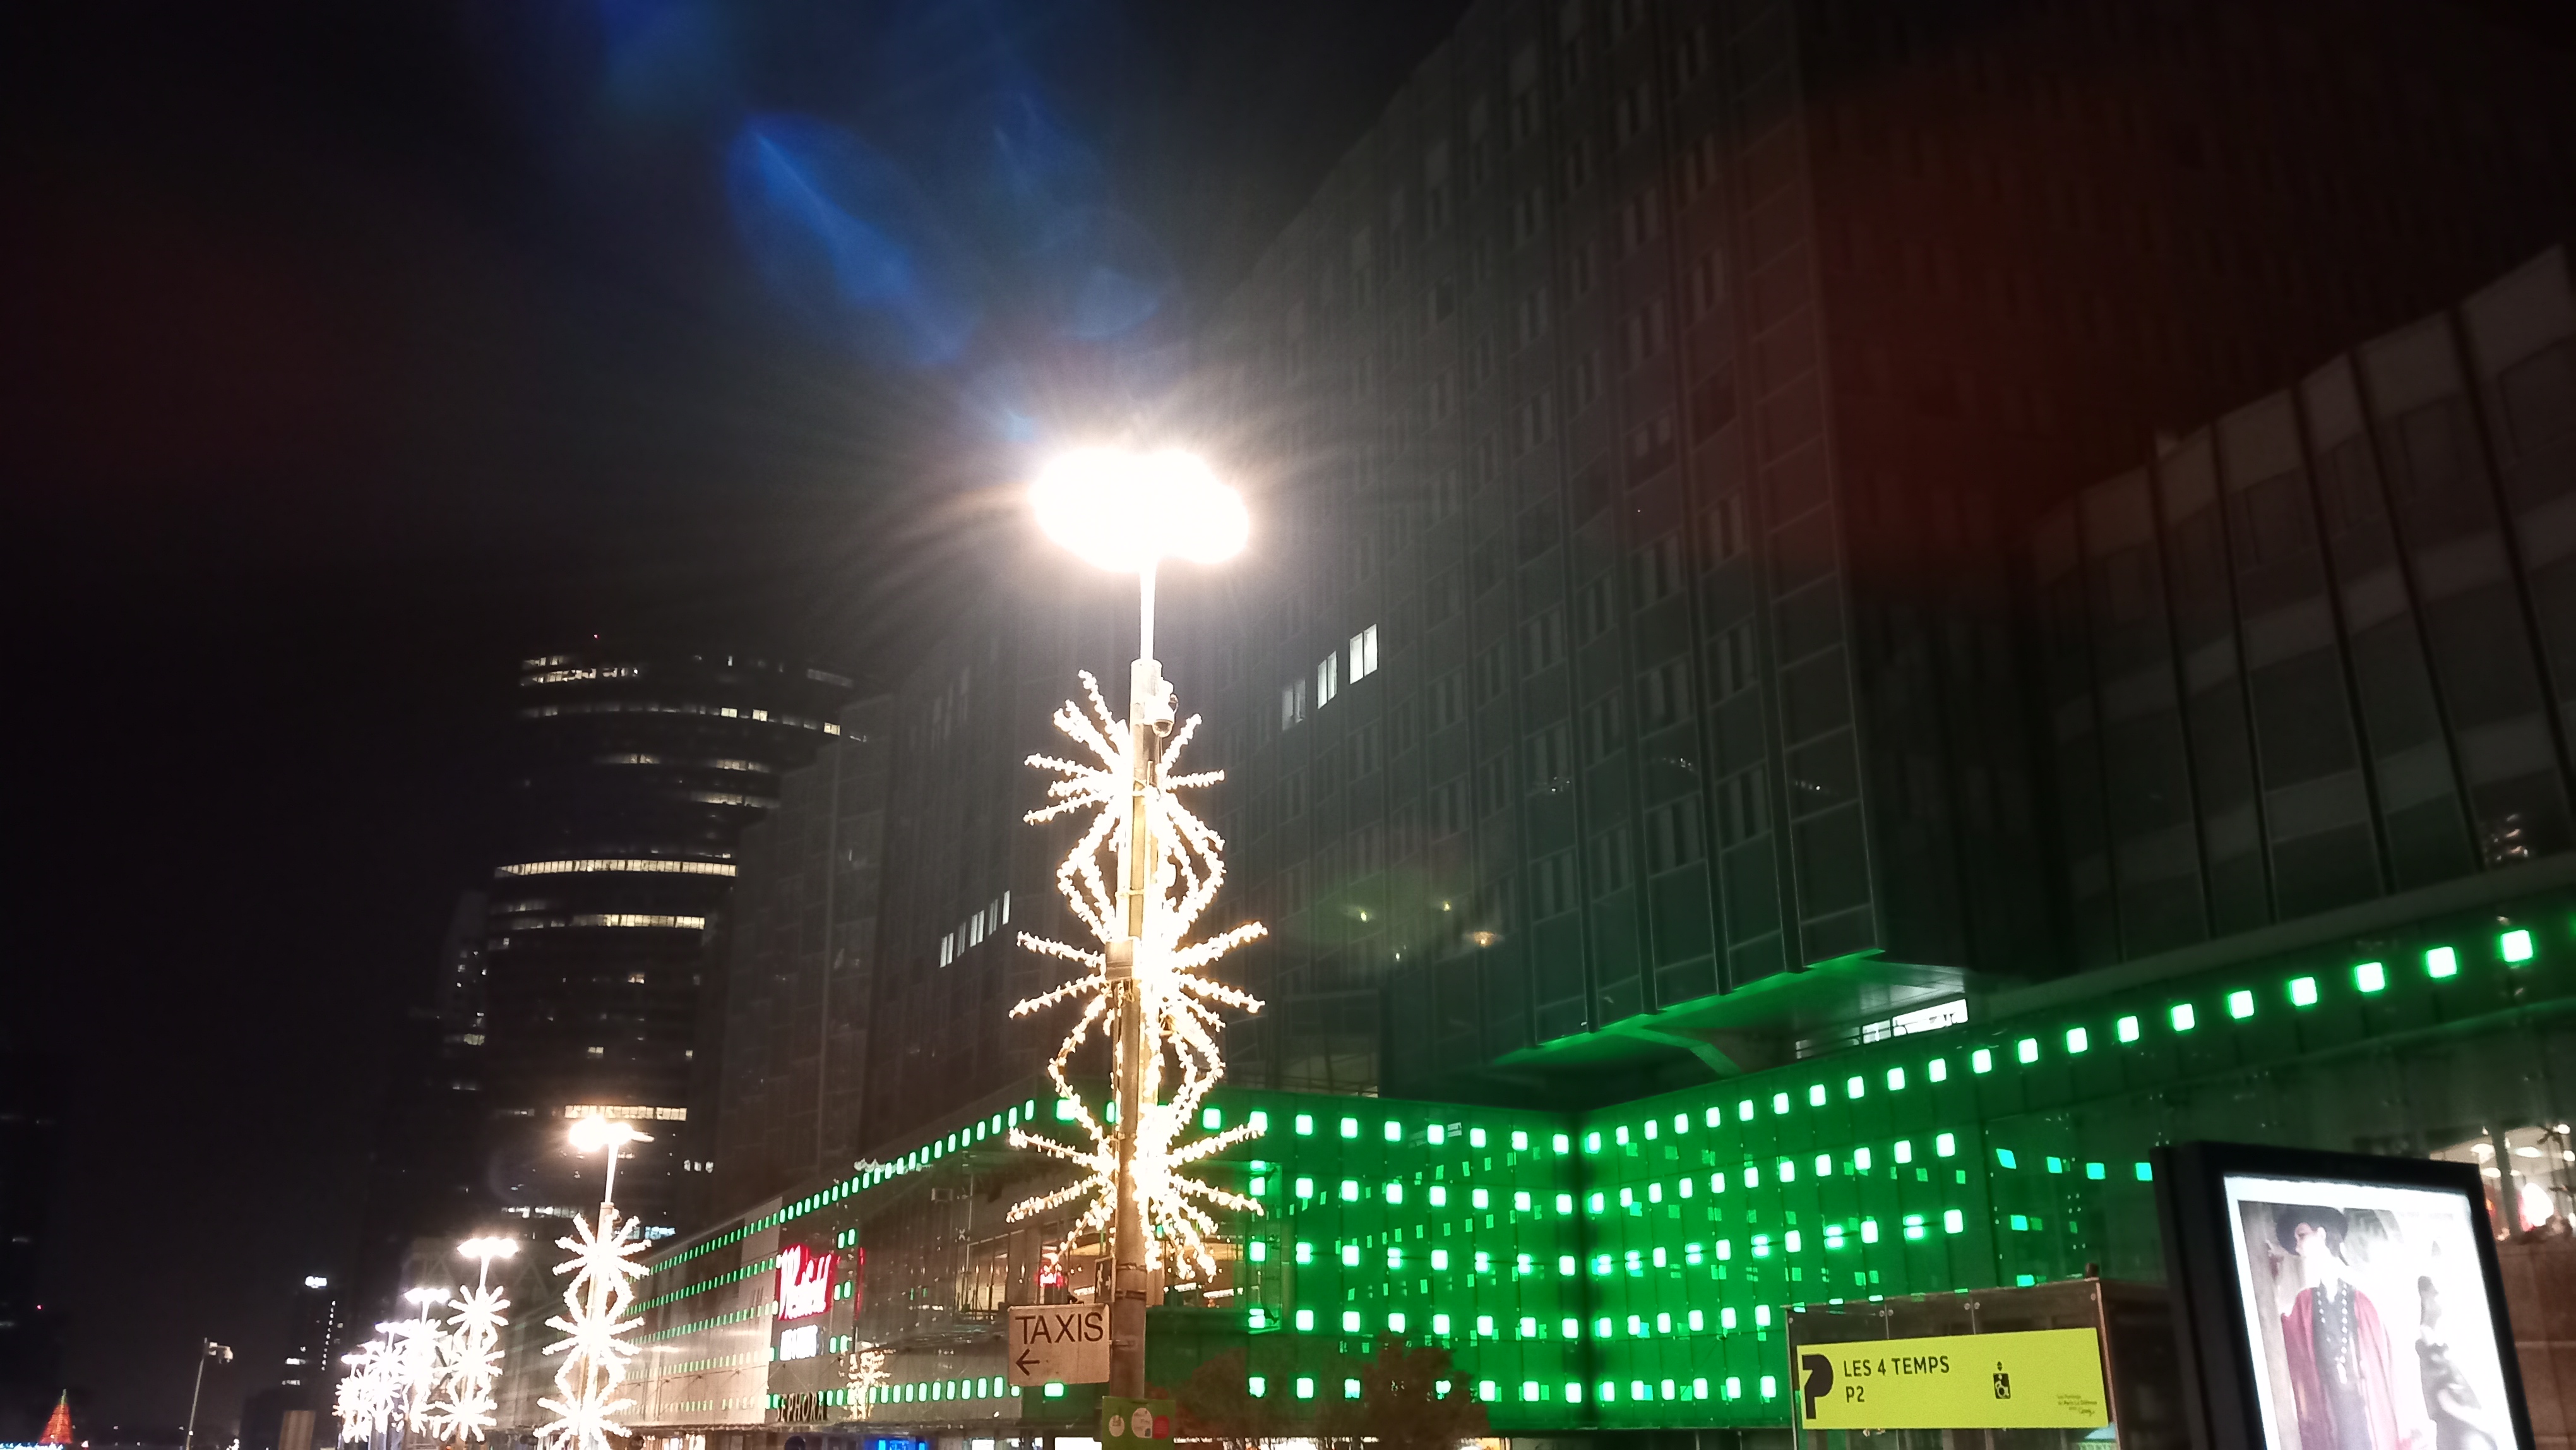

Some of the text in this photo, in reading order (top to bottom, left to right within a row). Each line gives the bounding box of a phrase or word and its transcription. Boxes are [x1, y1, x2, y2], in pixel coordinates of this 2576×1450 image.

[1015, 1312, 1103, 1345] TAXIS
[1844, 1355, 1950, 1377] LES 4 TEMPS
[1846, 1386, 1865, 1403] P2
